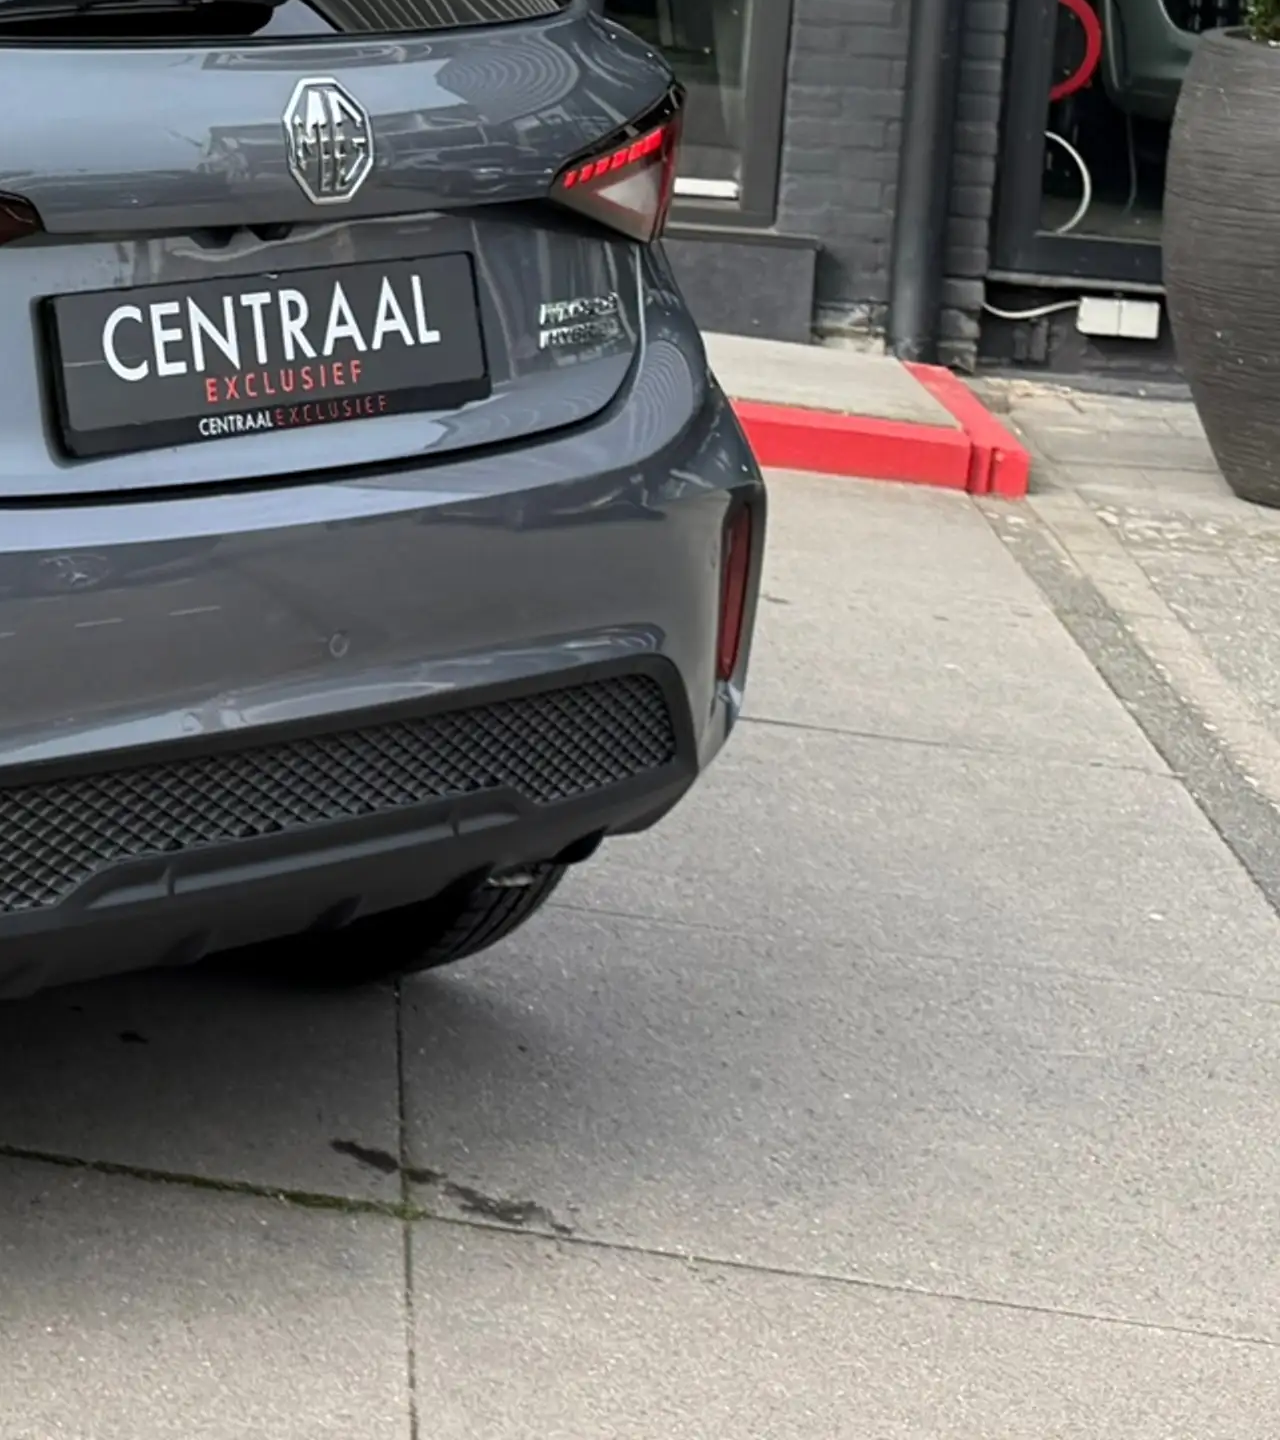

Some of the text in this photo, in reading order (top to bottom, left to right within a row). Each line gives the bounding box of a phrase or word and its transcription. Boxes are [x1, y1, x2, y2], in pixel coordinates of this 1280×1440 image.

[102, 274, 441, 382] CENTRAAL
[205, 360, 362, 402] EXCLUSIEF
[198, 395, 387, 436] CENTRAAL EXCLUSIEF
